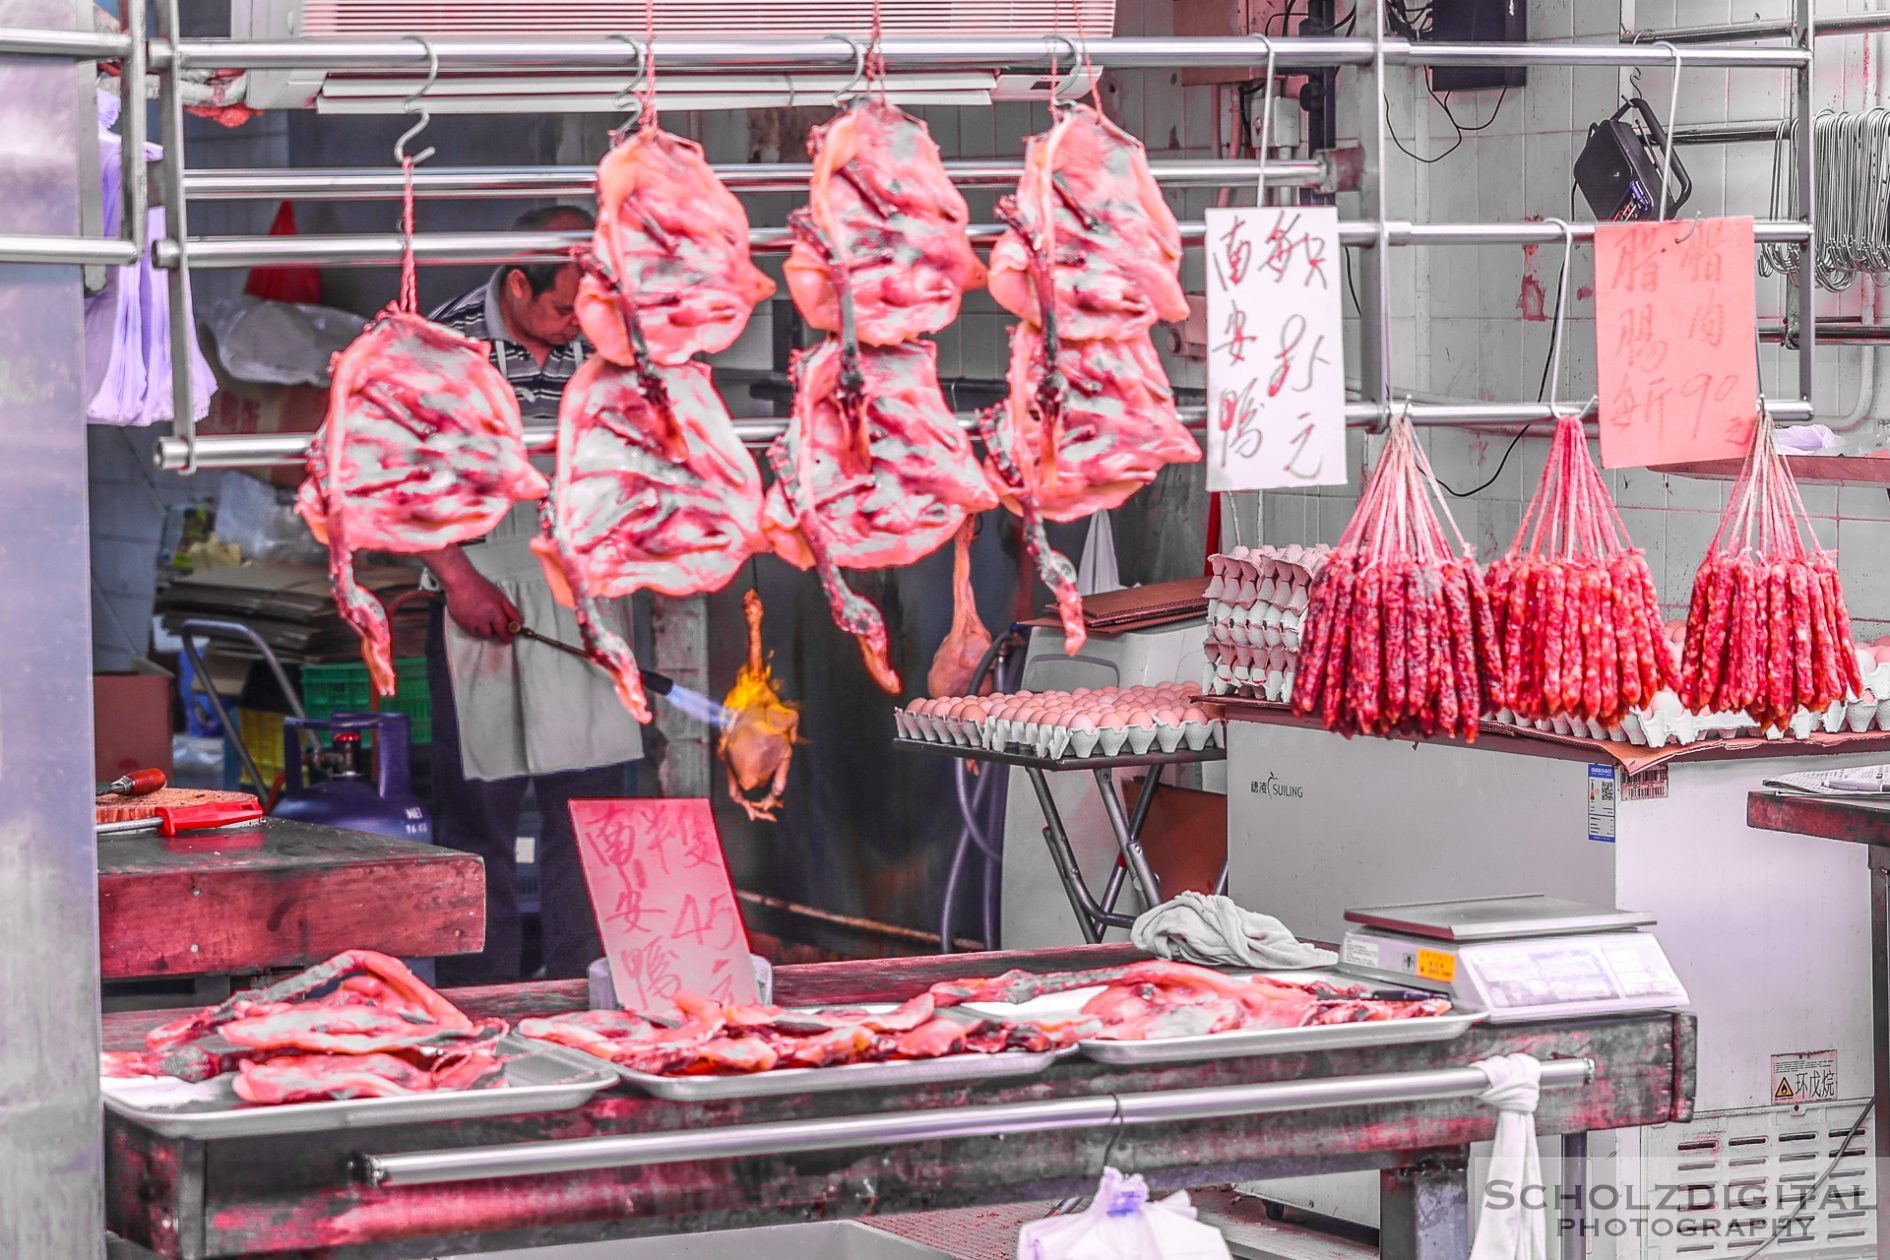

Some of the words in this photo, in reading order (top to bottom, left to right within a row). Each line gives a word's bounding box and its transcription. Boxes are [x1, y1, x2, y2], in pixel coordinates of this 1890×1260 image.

[1272, 783, 1303, 798] SUILING
[1795, 1069, 1835, 1099] 环戊烷
